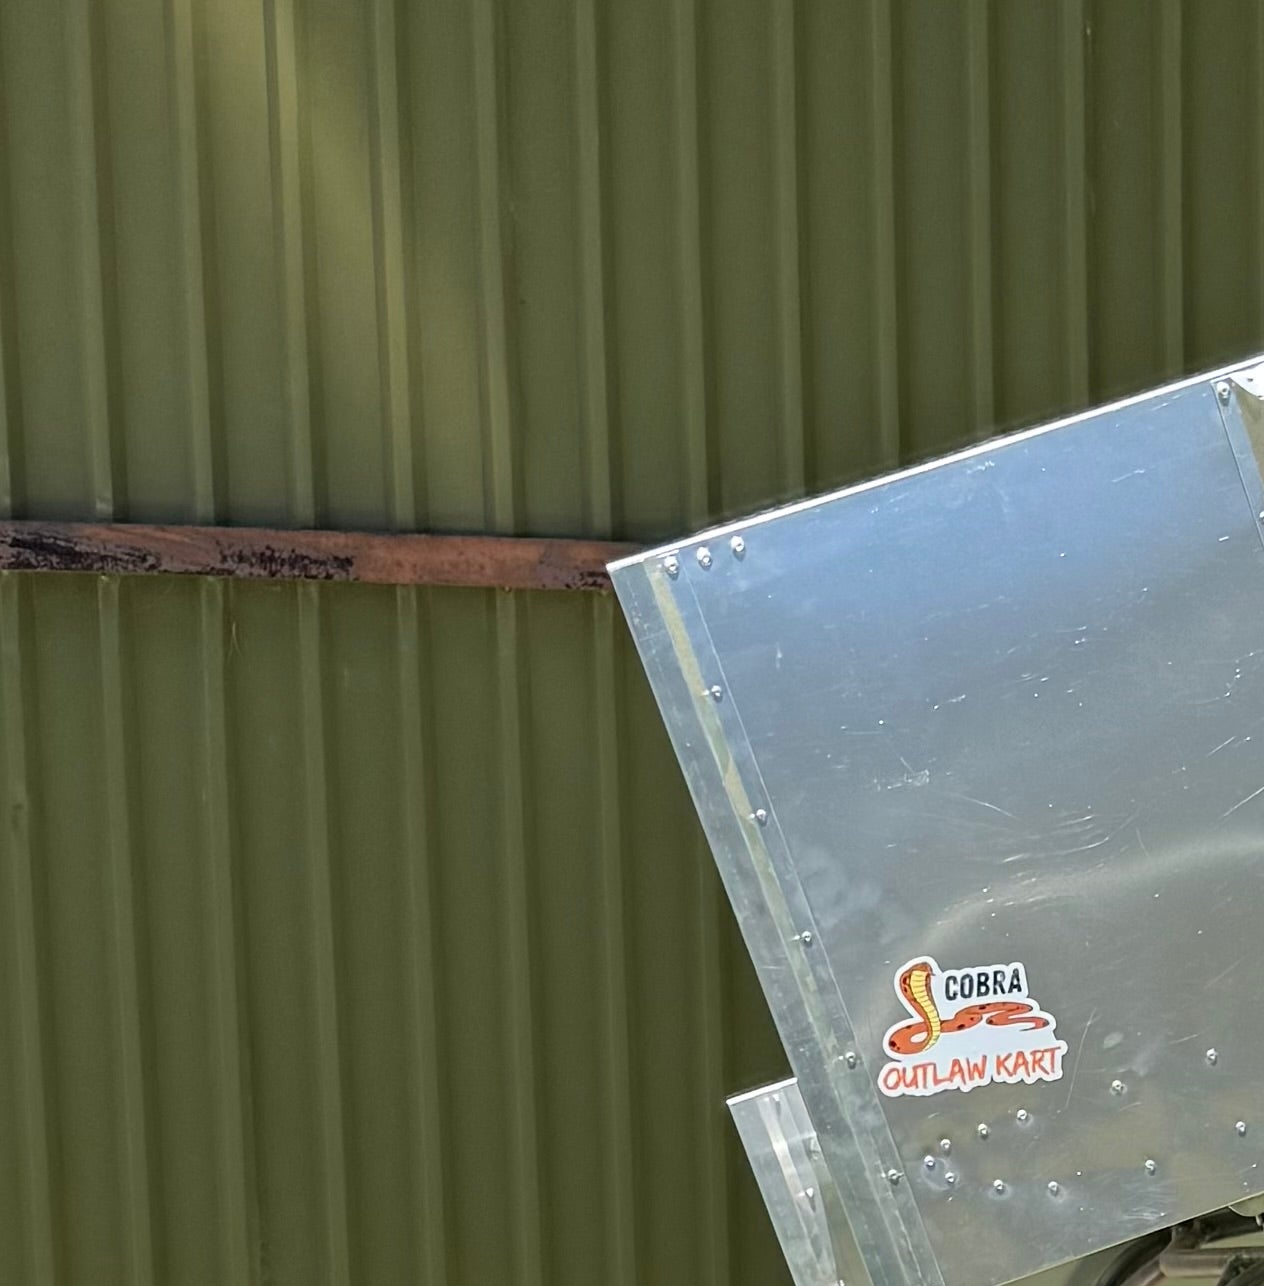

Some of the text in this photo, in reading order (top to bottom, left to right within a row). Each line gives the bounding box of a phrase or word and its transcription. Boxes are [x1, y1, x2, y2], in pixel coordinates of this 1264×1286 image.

[945, 968, 1022, 1001] COBRA
[883, 1047, 1061, 1090] OUTLAW KART
